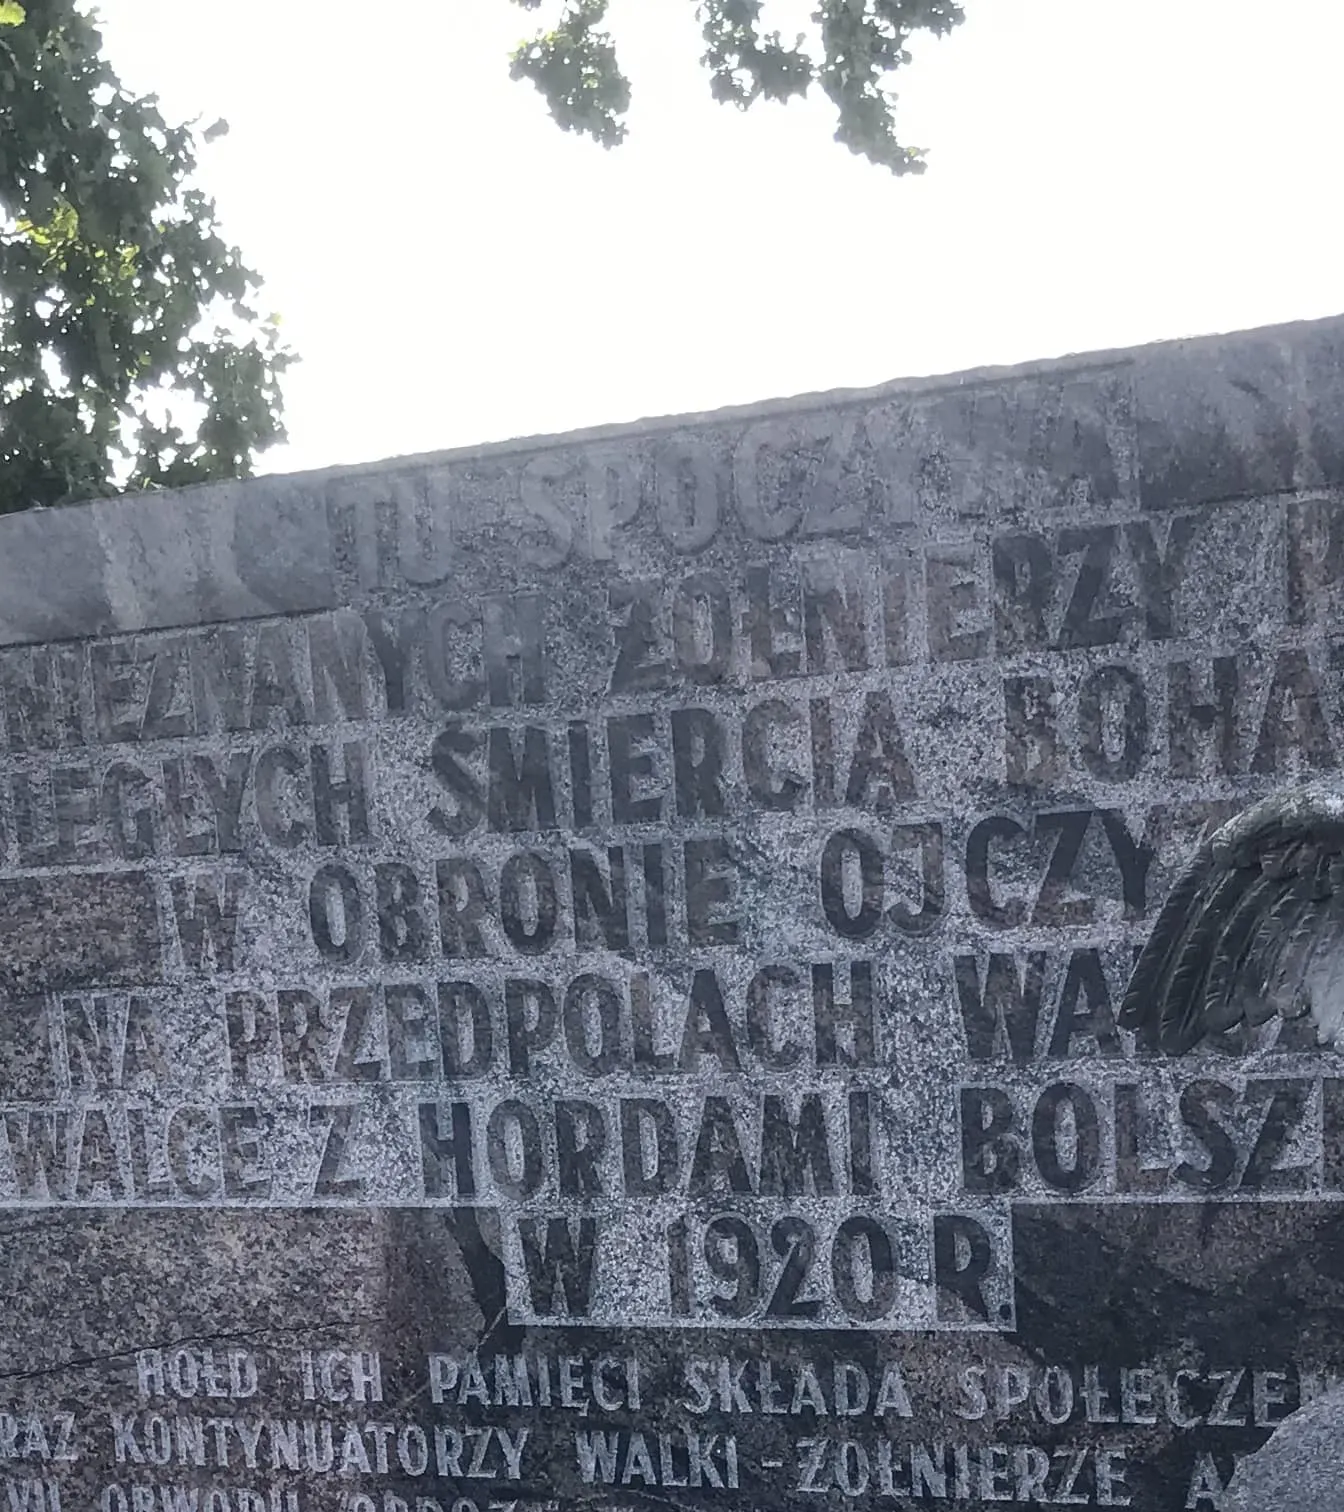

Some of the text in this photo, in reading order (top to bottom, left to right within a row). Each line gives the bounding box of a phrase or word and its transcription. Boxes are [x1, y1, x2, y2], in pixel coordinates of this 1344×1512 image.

[327, 475, 449, 592] TU
[1, 594, 544, 754] NIEZNANYCH
[307, 836, 744, 964] OBRONIE
[228, 956, 879, 1086] PRZEDPOLACH
[3, 1103, 263, 1202] WALCE
[311, 1103, 375, 1198] Z
[419, 1087, 878, 1202] HORDAMI
[517, 1213, 1015, 1325] W 1920 R.
[136, 1347, 258, 1400] HOŁD
[302, 1347, 384, 1403] ICH
[427, 1350, 642, 1418] PAMIĘCI
[682, 1354, 913, 1419] SKŁADA
[113, 1415, 530, 1482] KONTYNUATORZY
[576, 1429, 740, 1490] WALKI
